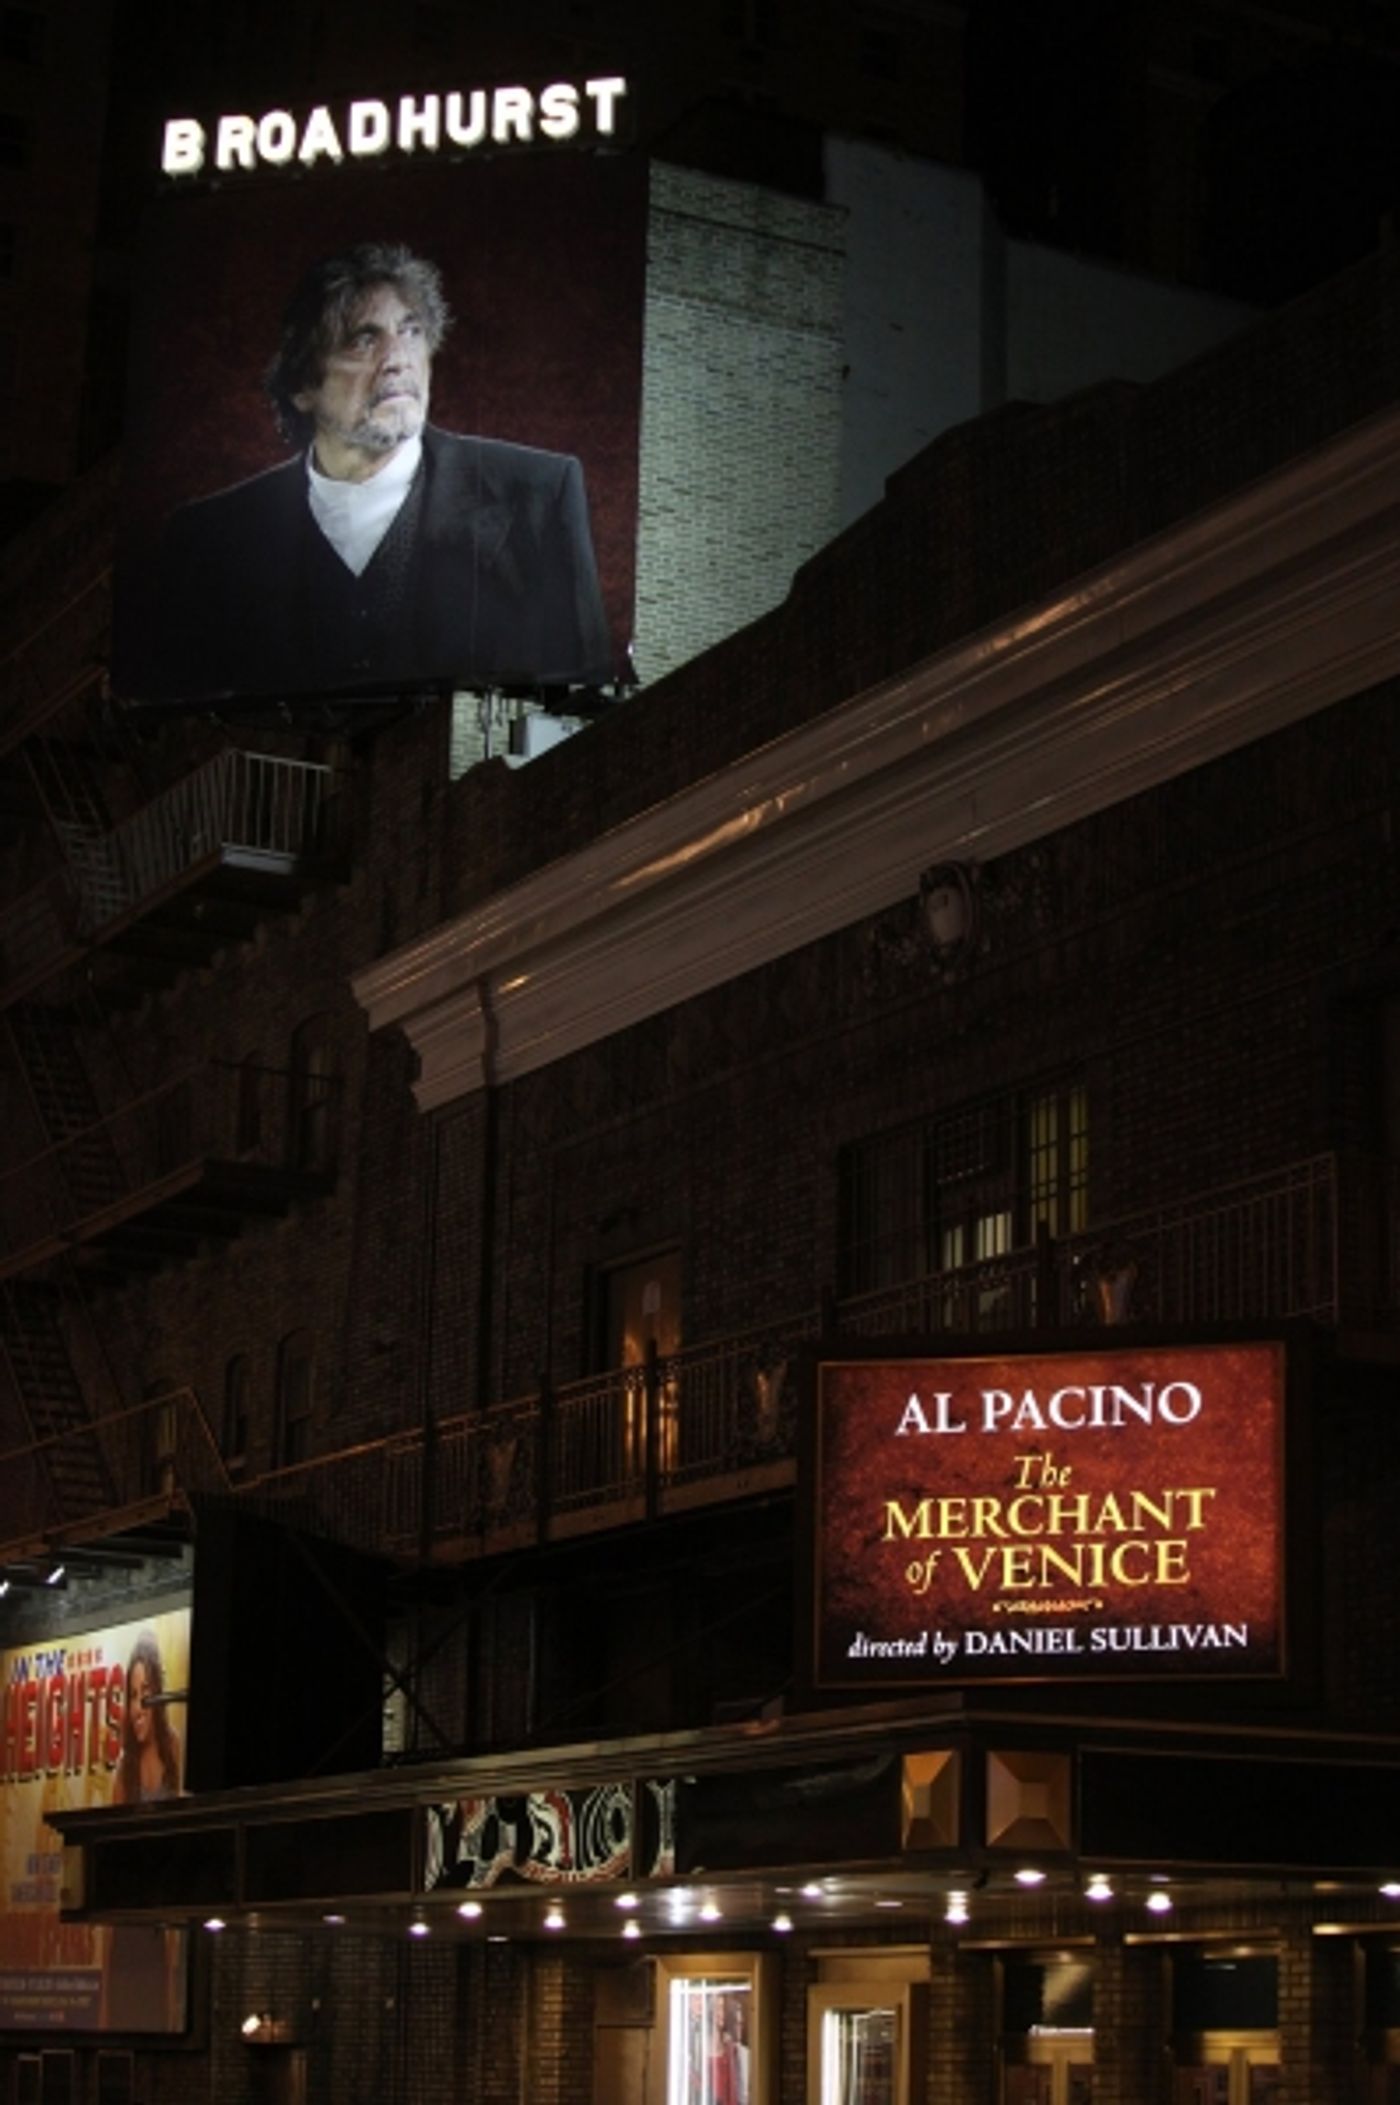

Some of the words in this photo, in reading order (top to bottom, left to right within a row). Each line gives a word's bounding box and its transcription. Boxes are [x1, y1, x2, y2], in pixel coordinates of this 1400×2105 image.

[162, 77, 625, 172] BROADHURST
[896, 1392, 965, 1434] AL
[981, 1382, 1202, 1431] PACINO
[1014, 1452, 1072, 1489] The
[882, 1488, 1216, 1541] MERCHANT
[906, 1551, 941, 1594] of
[952, 1541, 1191, 1590] VENICE
[35, 1649, 66, 1677] THE
[847, 1632, 926, 1658] directed
[933, 1631, 959, 1664] by
[964, 1627, 1083, 1655] DANIEL
[1090, 1624, 1248, 1651] SULLIVAN
[0, 1664, 125, 1782] HEIGHTS
